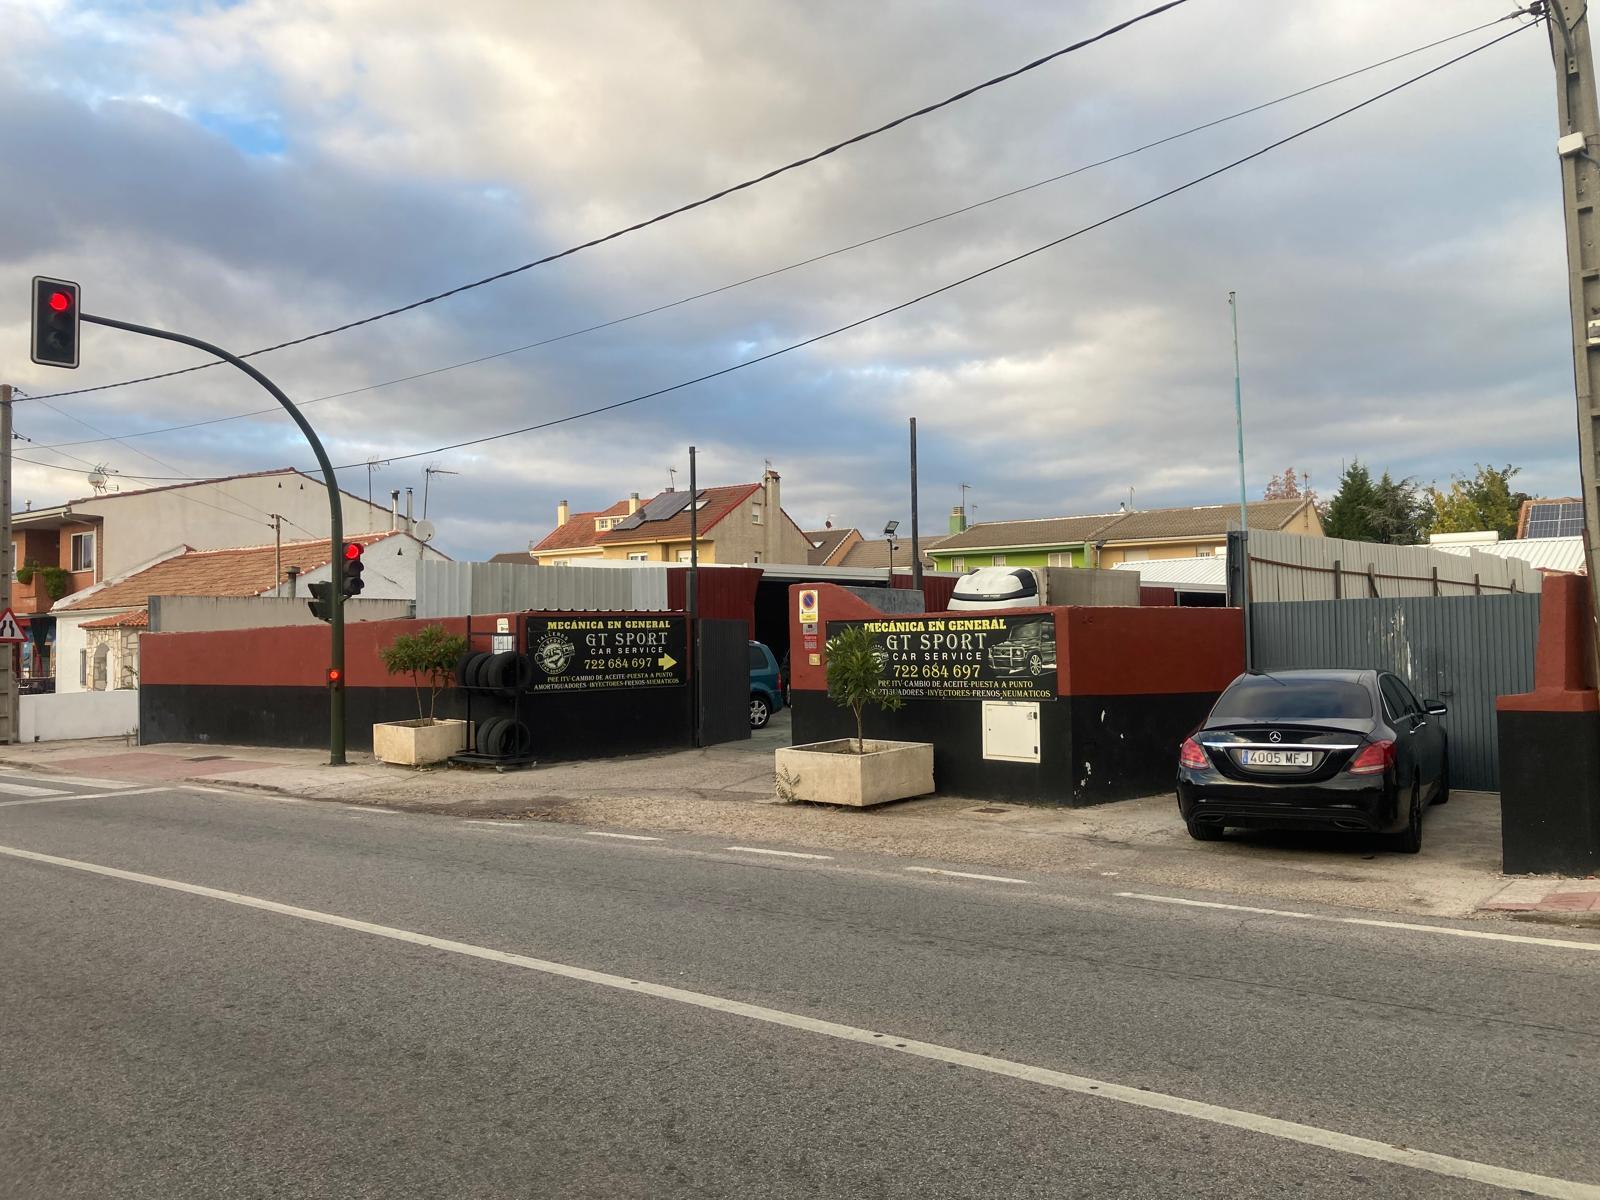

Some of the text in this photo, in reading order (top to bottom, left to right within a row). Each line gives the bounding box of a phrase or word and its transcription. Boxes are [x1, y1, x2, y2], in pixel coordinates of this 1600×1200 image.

[547, 619, 604, 630] MECÁNICA
[625, 620, 671, 629] GENERAL
[864, 618, 1006, 632] MECÁNICA EN GENERAL
[586, 632, 668, 646] GT SPORT
[886, 633, 988, 650] GT SPORT
[892, 651, 983, 661] CAR SERVICE
[584, 657, 652, 669] 722 684 697
[892, 663, 981, 680] 722 684 697
[932, 680, 941, 688] DE
[1009, 680, 1033, 688] PUNTO
[1250, 752, 1309, 764] 4005 MFJ
